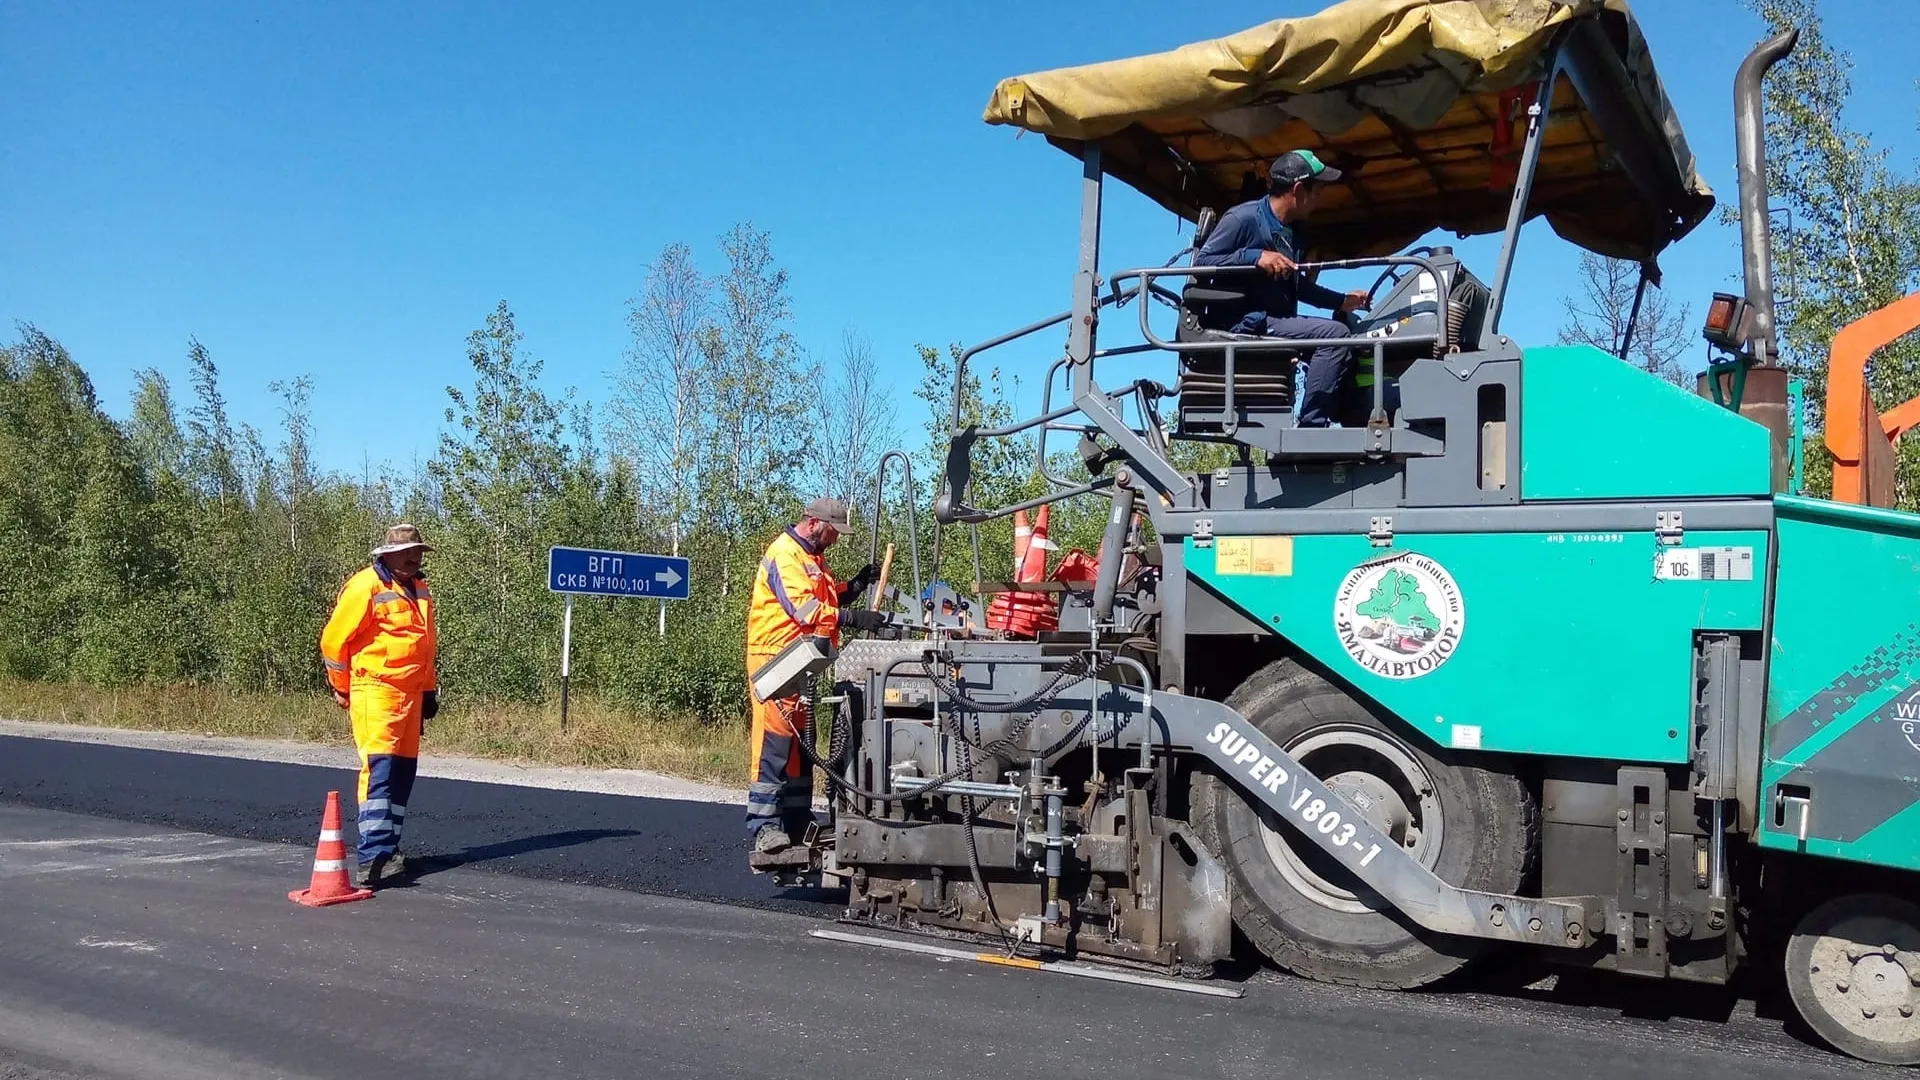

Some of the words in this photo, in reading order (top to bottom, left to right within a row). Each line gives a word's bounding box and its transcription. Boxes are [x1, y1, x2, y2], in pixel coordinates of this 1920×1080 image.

[557, 573, 587, 588] СКВ
[592, 576, 650, 592] №100,101
[588, 555, 623, 575] ВГП
[1670, 562, 1690, 577] 106
[1416, 559, 1459, 613] общество
[1338, 621, 1458, 677] ЯМАЛАВТОДОР
[1206, 722, 1289, 795] SUPER
[1289, 787, 1382, 867] 1803-1
